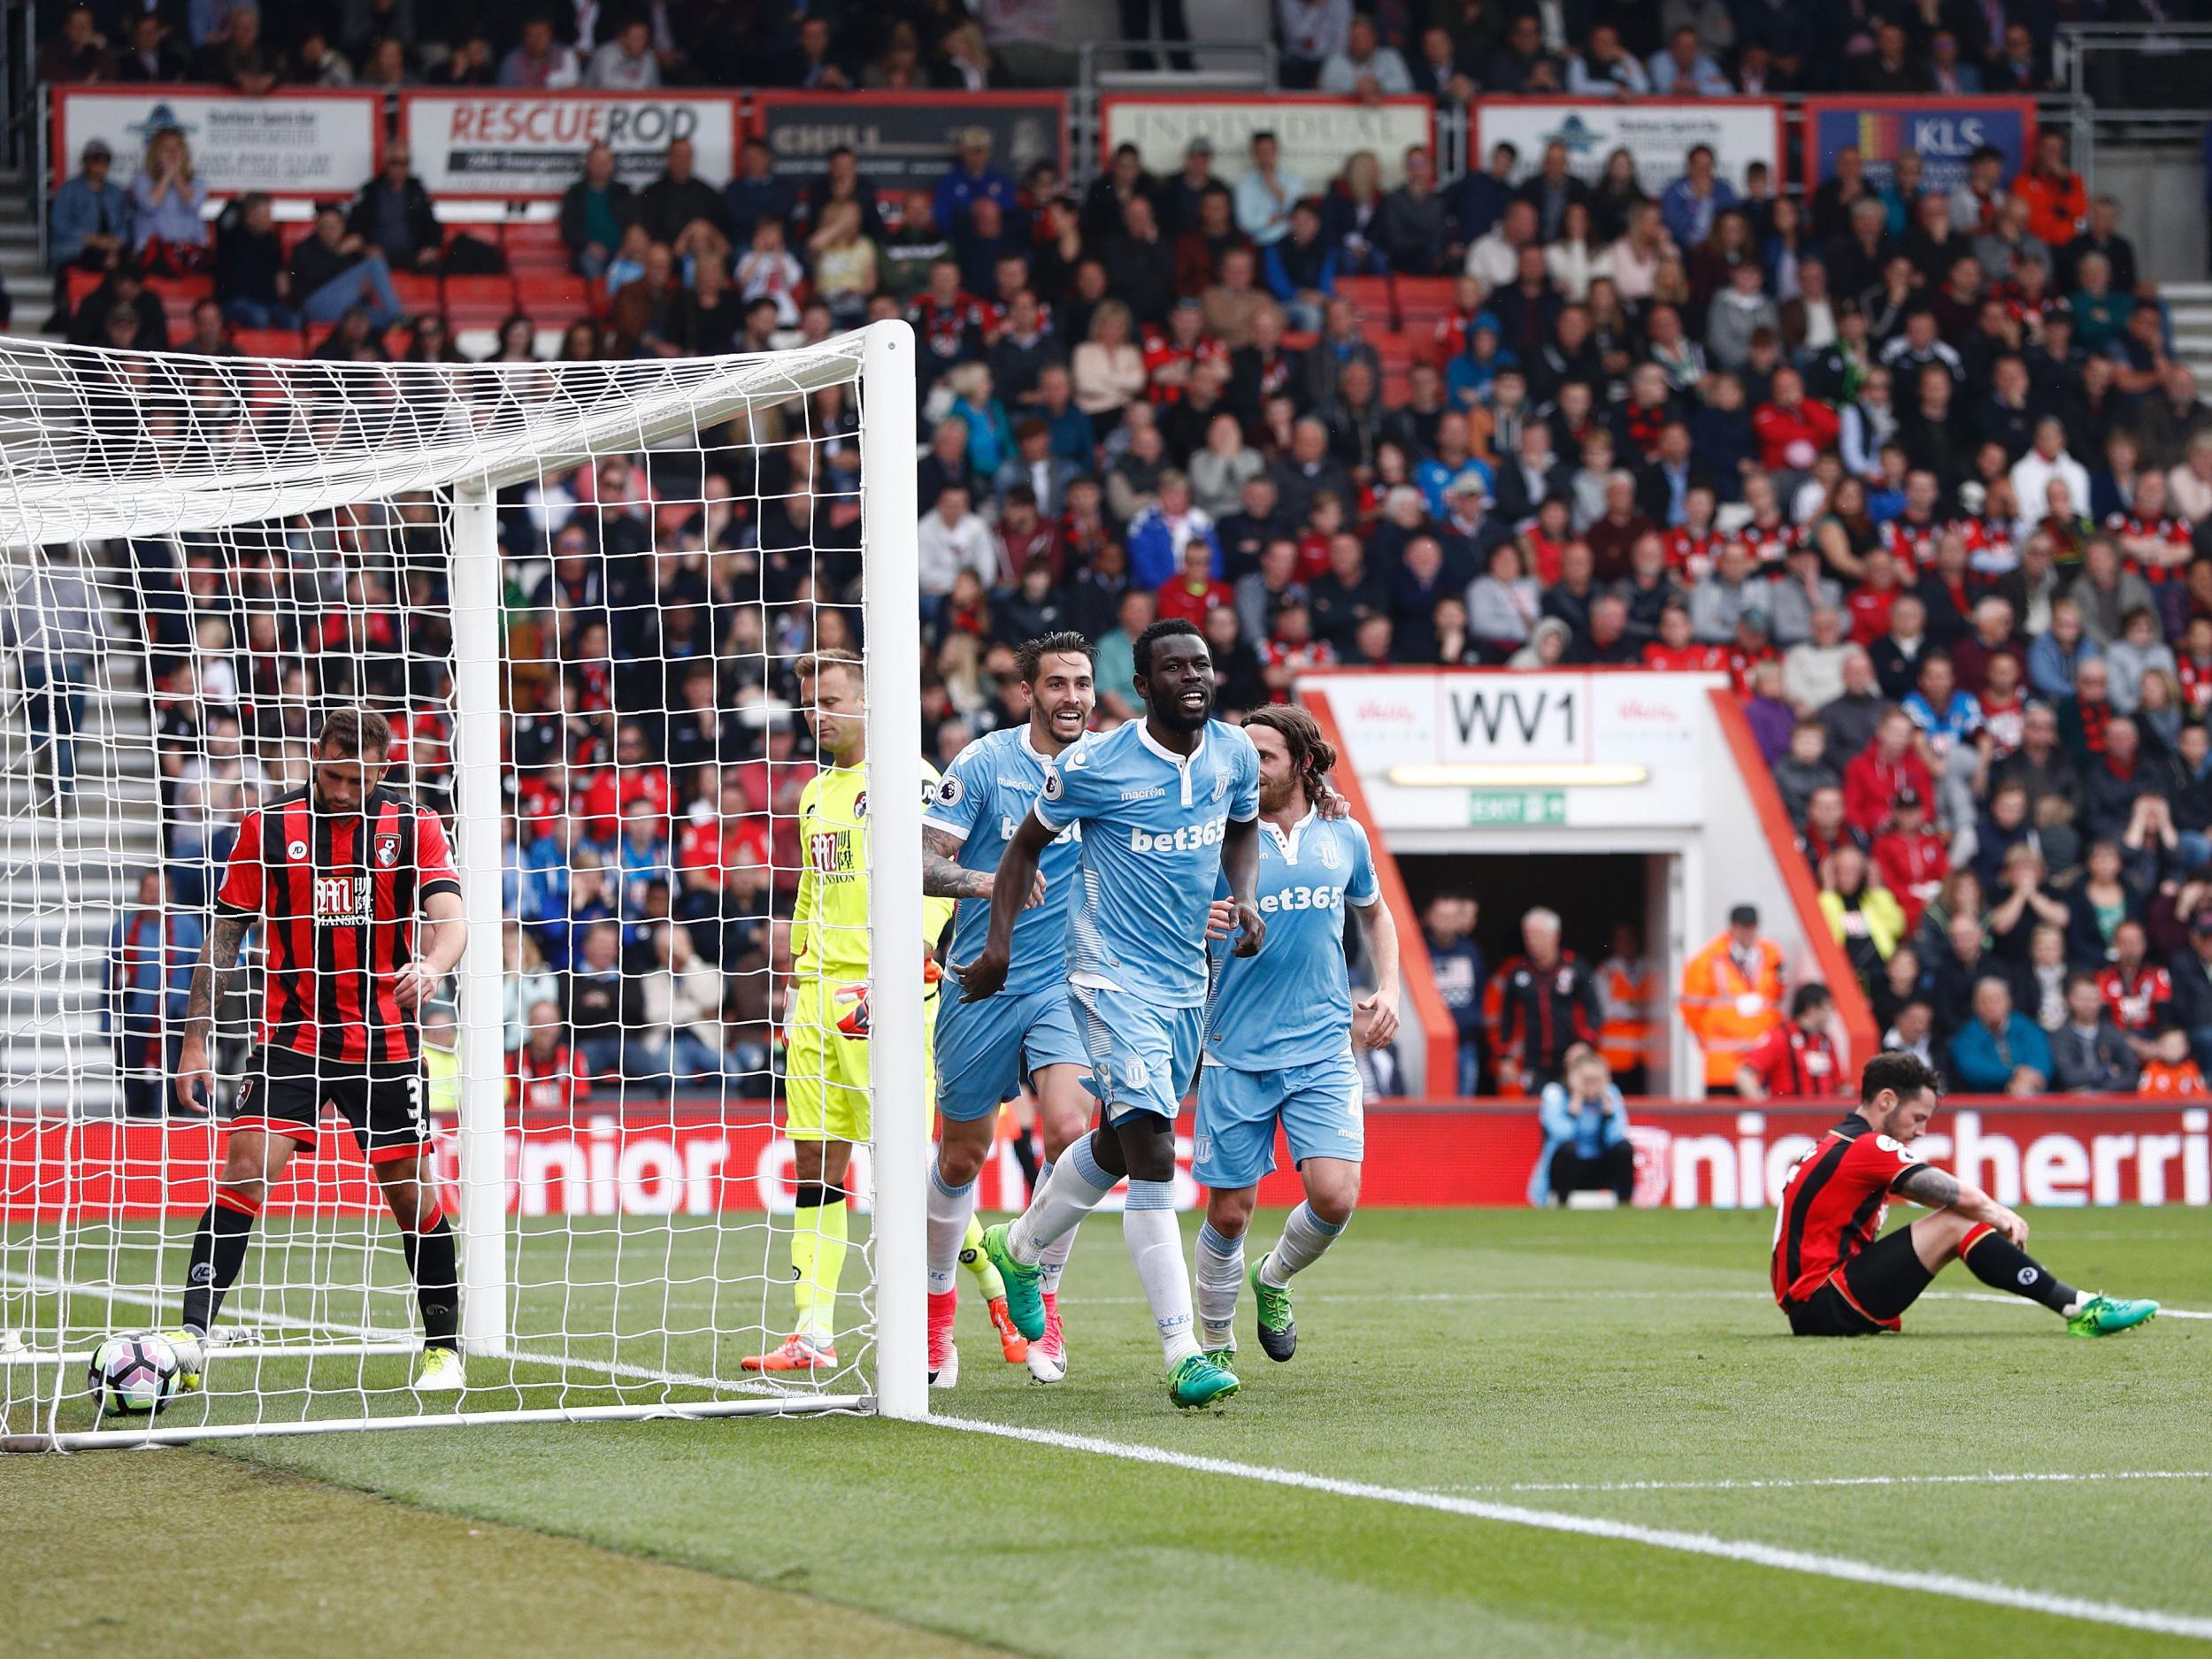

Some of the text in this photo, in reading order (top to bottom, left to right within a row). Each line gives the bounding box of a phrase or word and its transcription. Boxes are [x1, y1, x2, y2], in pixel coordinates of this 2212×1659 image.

[449, 104, 697, 144] RESCUEROD
[1914, 117, 1985, 156] KLS
[1449, 687, 1576, 745] WV1
[1120, 787, 1166, 802] macron
[1130, 814, 1226, 853] bet365
[1256, 886, 1343, 913] et365
